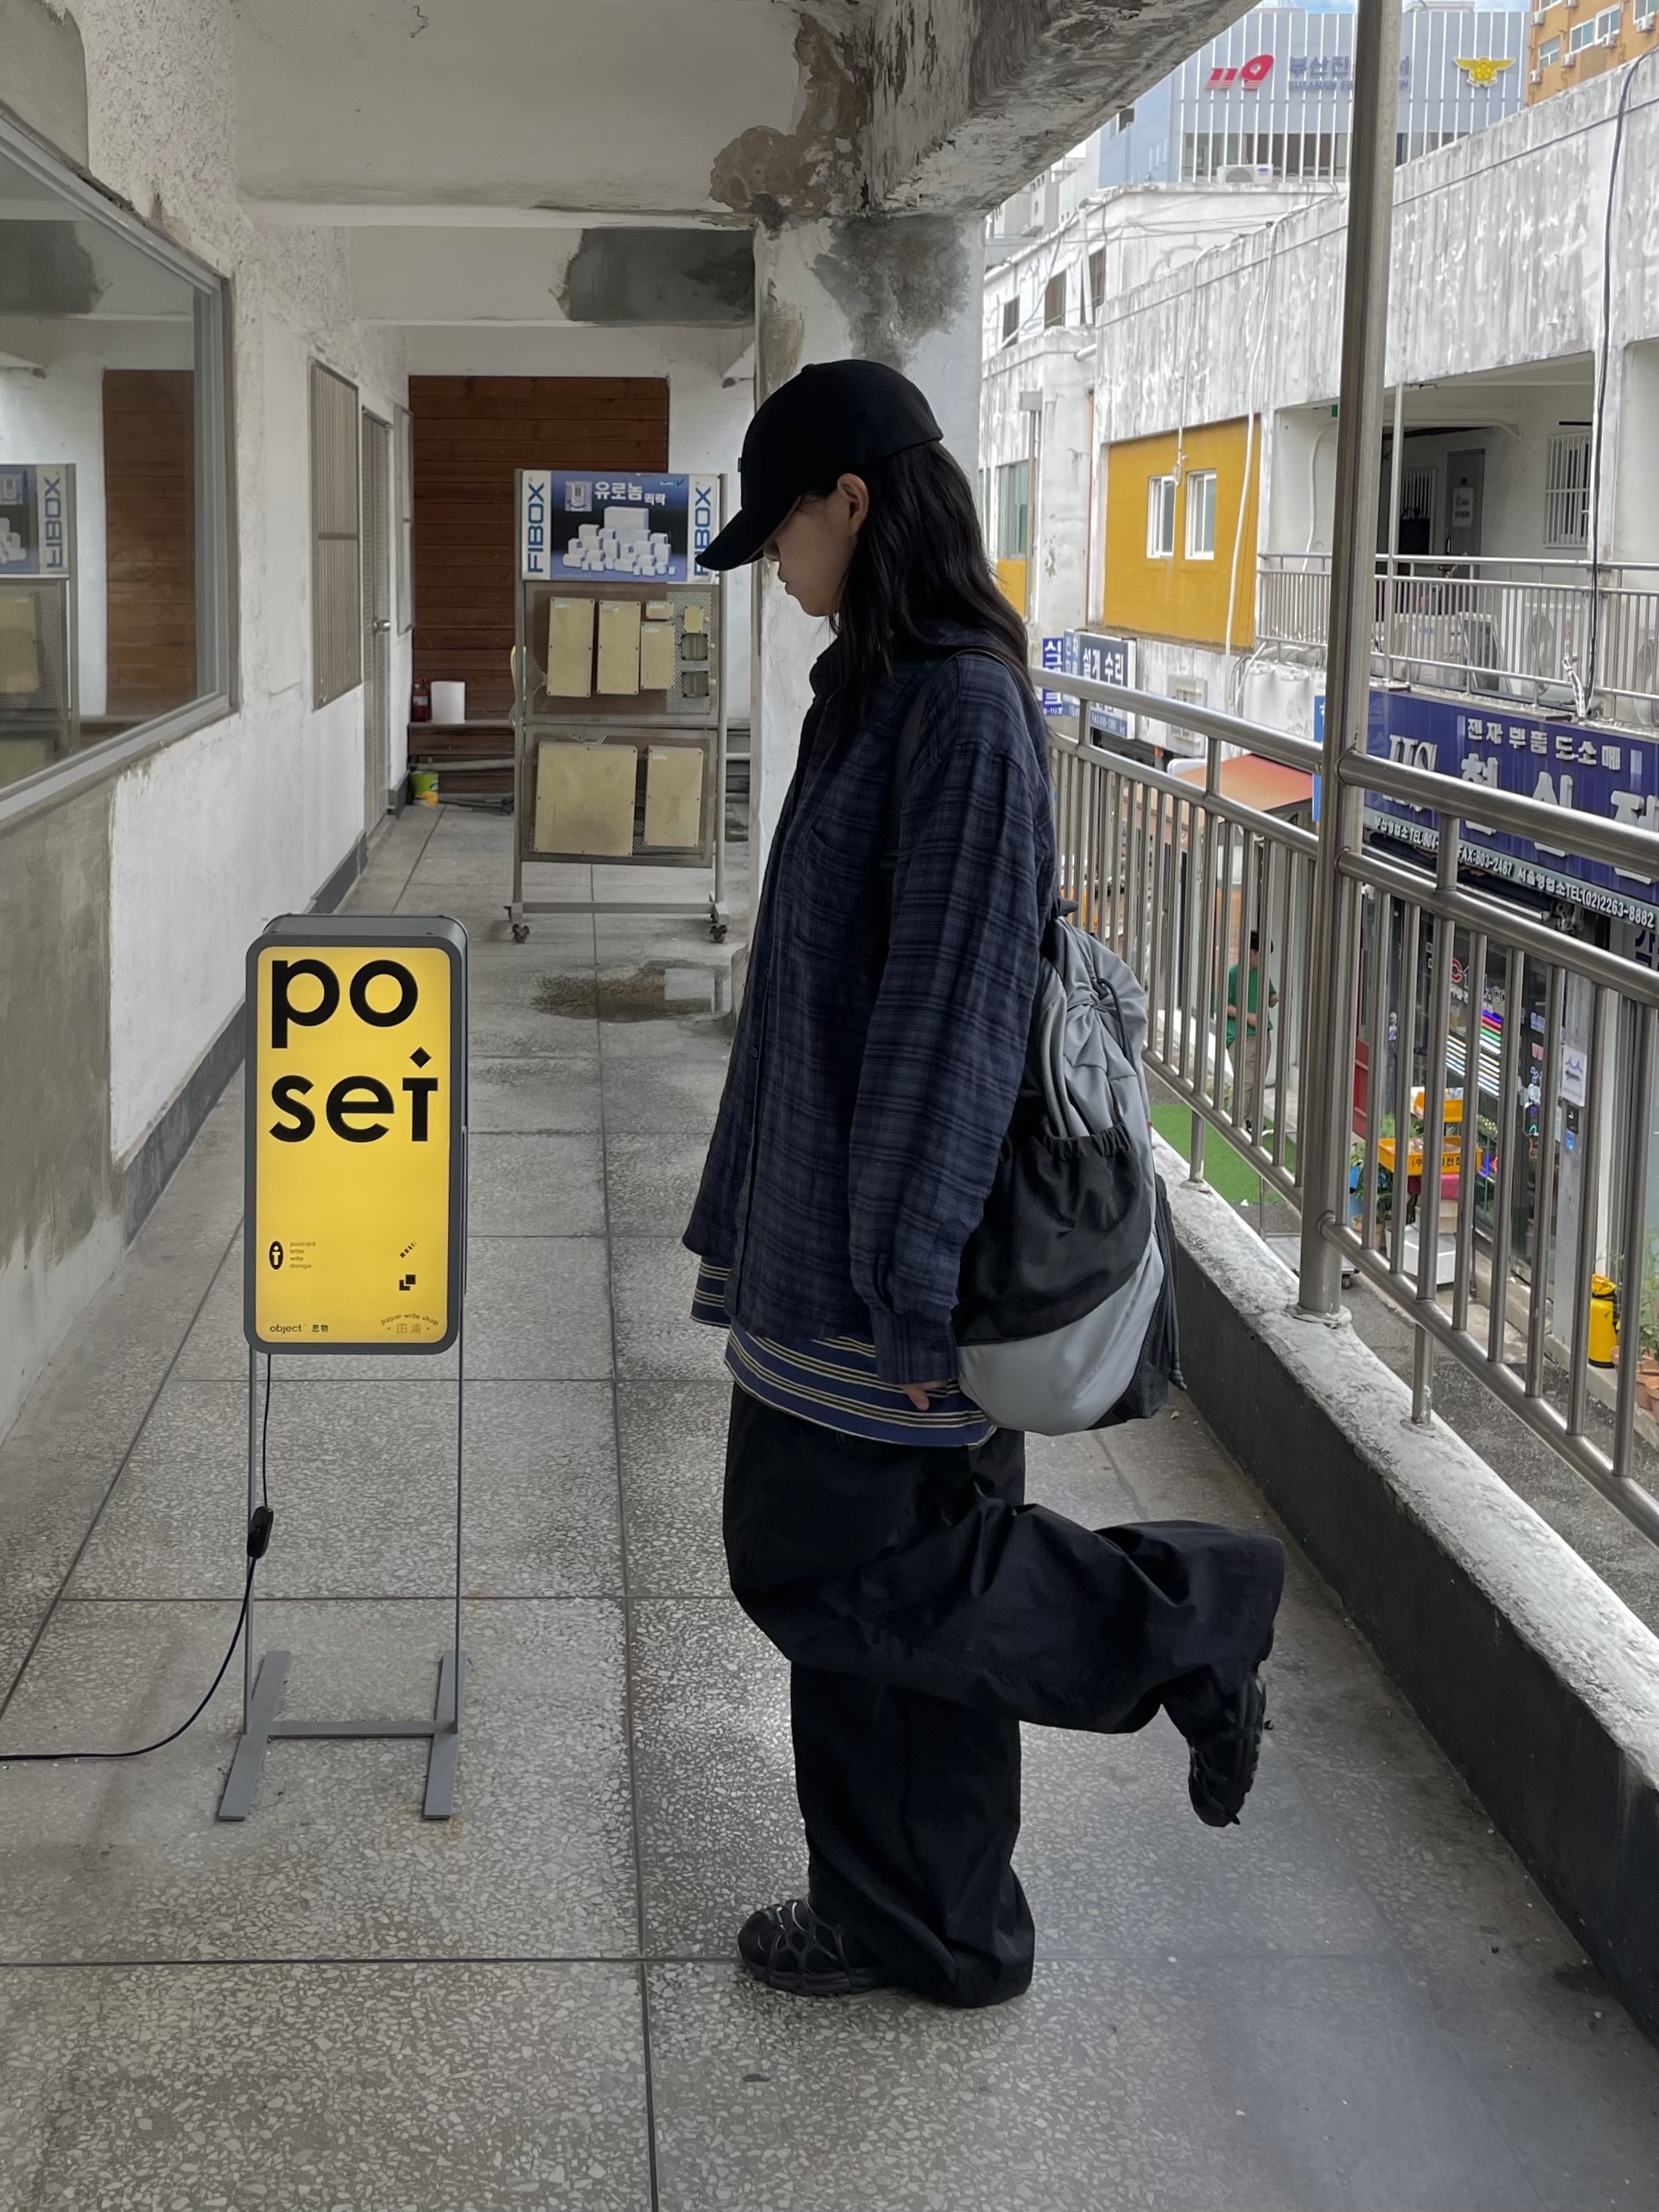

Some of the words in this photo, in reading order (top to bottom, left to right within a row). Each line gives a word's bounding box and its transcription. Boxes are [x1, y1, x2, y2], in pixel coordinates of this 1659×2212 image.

[1205, 54, 1275, 91] 119
[528, 482, 544, 573] FIBOX
[1468, 718, 1503, 745] 전자
[1508, 726, 1548, 755] 부품
[1555, 735, 1621, 771] 도소매
[271, 958, 419, 1048] po
[269, 1323, 303, 1335] object
[381, 1314, 402, 1326] paper
[422, 1316, 439, 1326] shop
